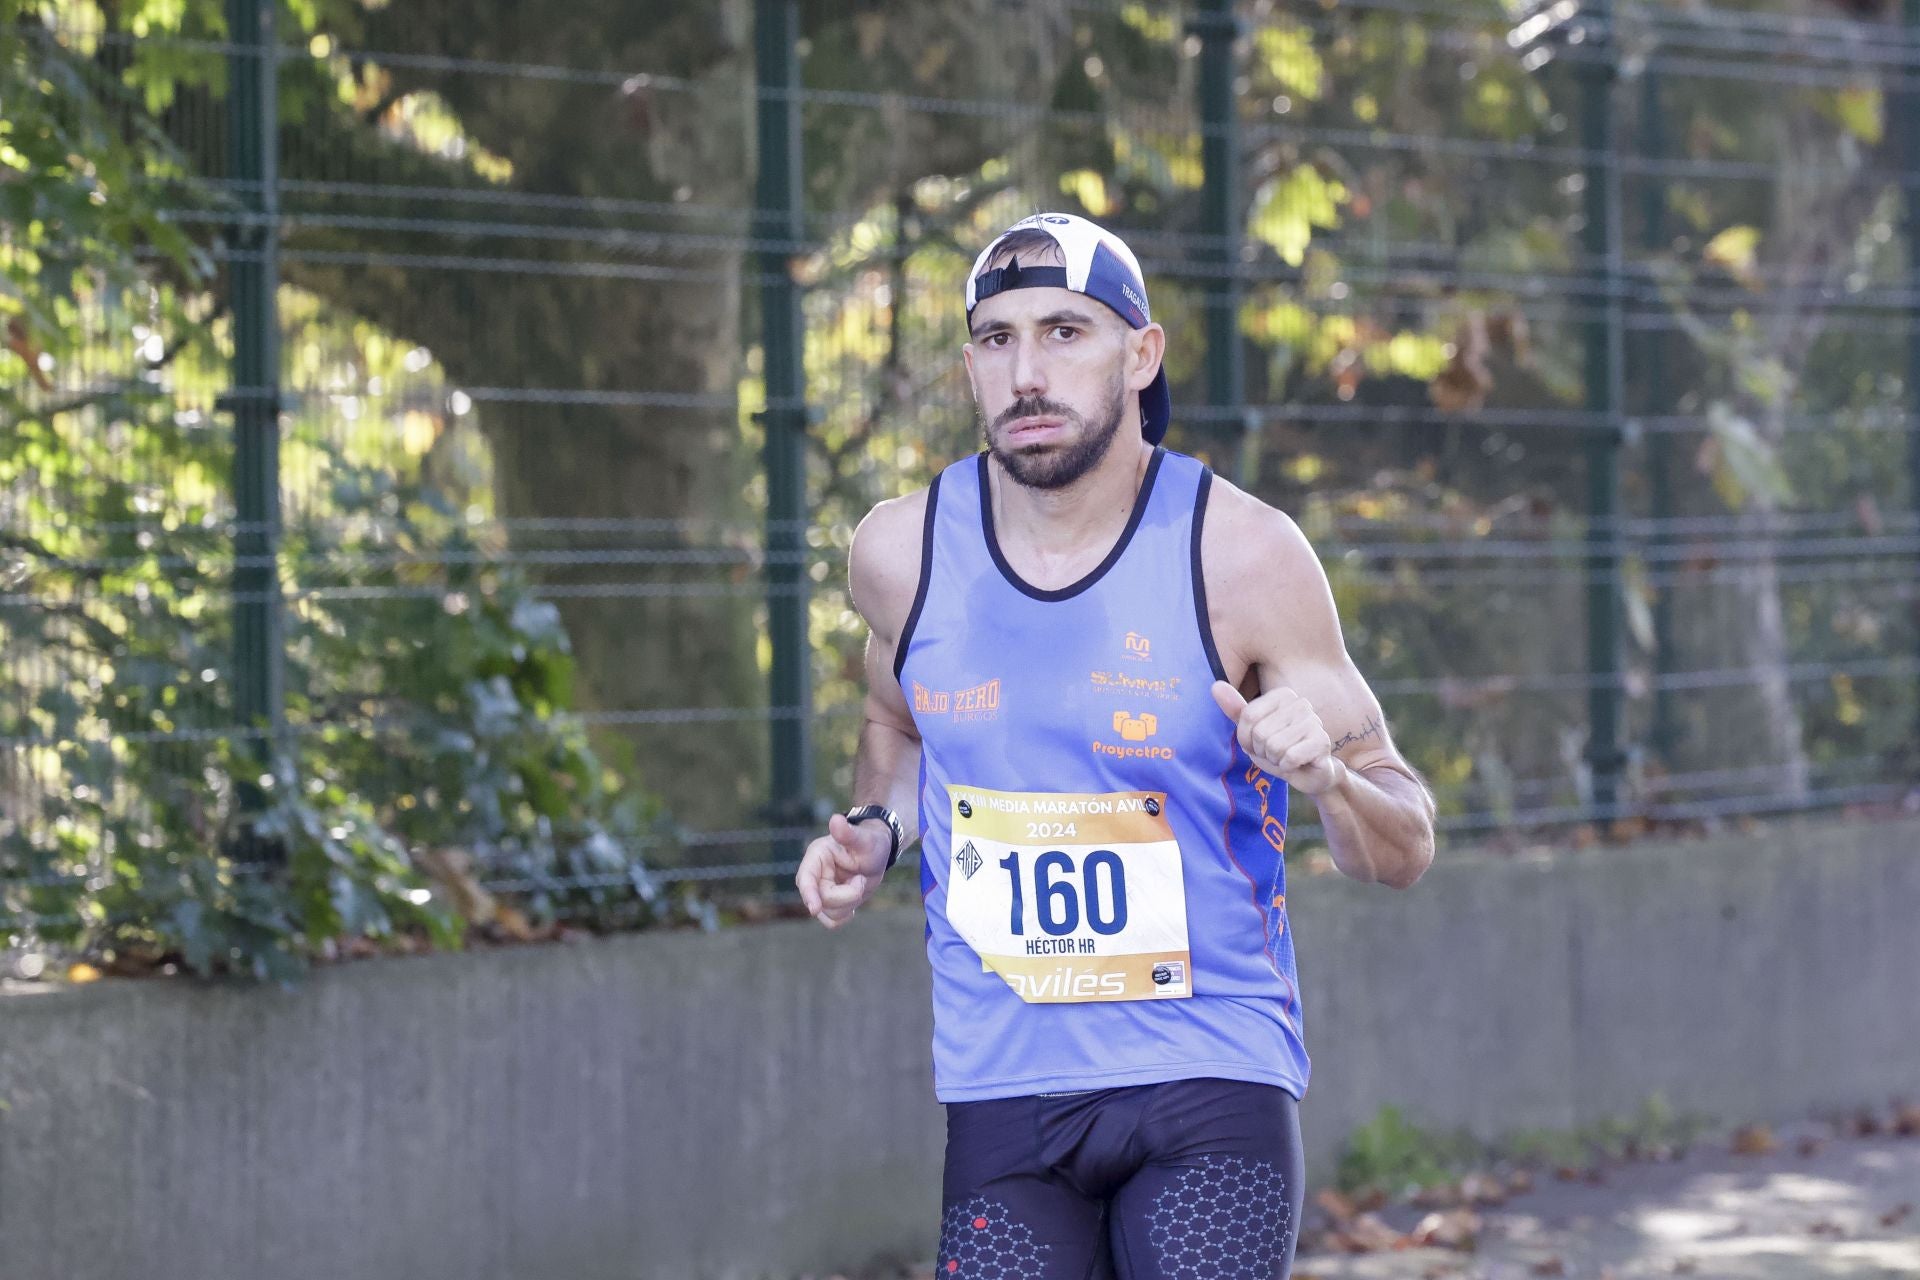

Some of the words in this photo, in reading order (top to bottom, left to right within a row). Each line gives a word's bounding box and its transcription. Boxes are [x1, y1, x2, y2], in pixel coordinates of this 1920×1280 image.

[912, 681, 949, 713] BAJO
[953, 679, 1000, 711] ZERO
[1092, 740, 1174, 760] ProyectPC
[989, 798, 1030, 814] MEDIA
[1033, 796, 1113, 815] MARATÓN
[1026, 822, 1077, 839] 2024
[999, 849, 1128, 936] 160
[1026, 937, 1075, 955] HÉCTOR
[1078, 938, 1096, 954] HR
